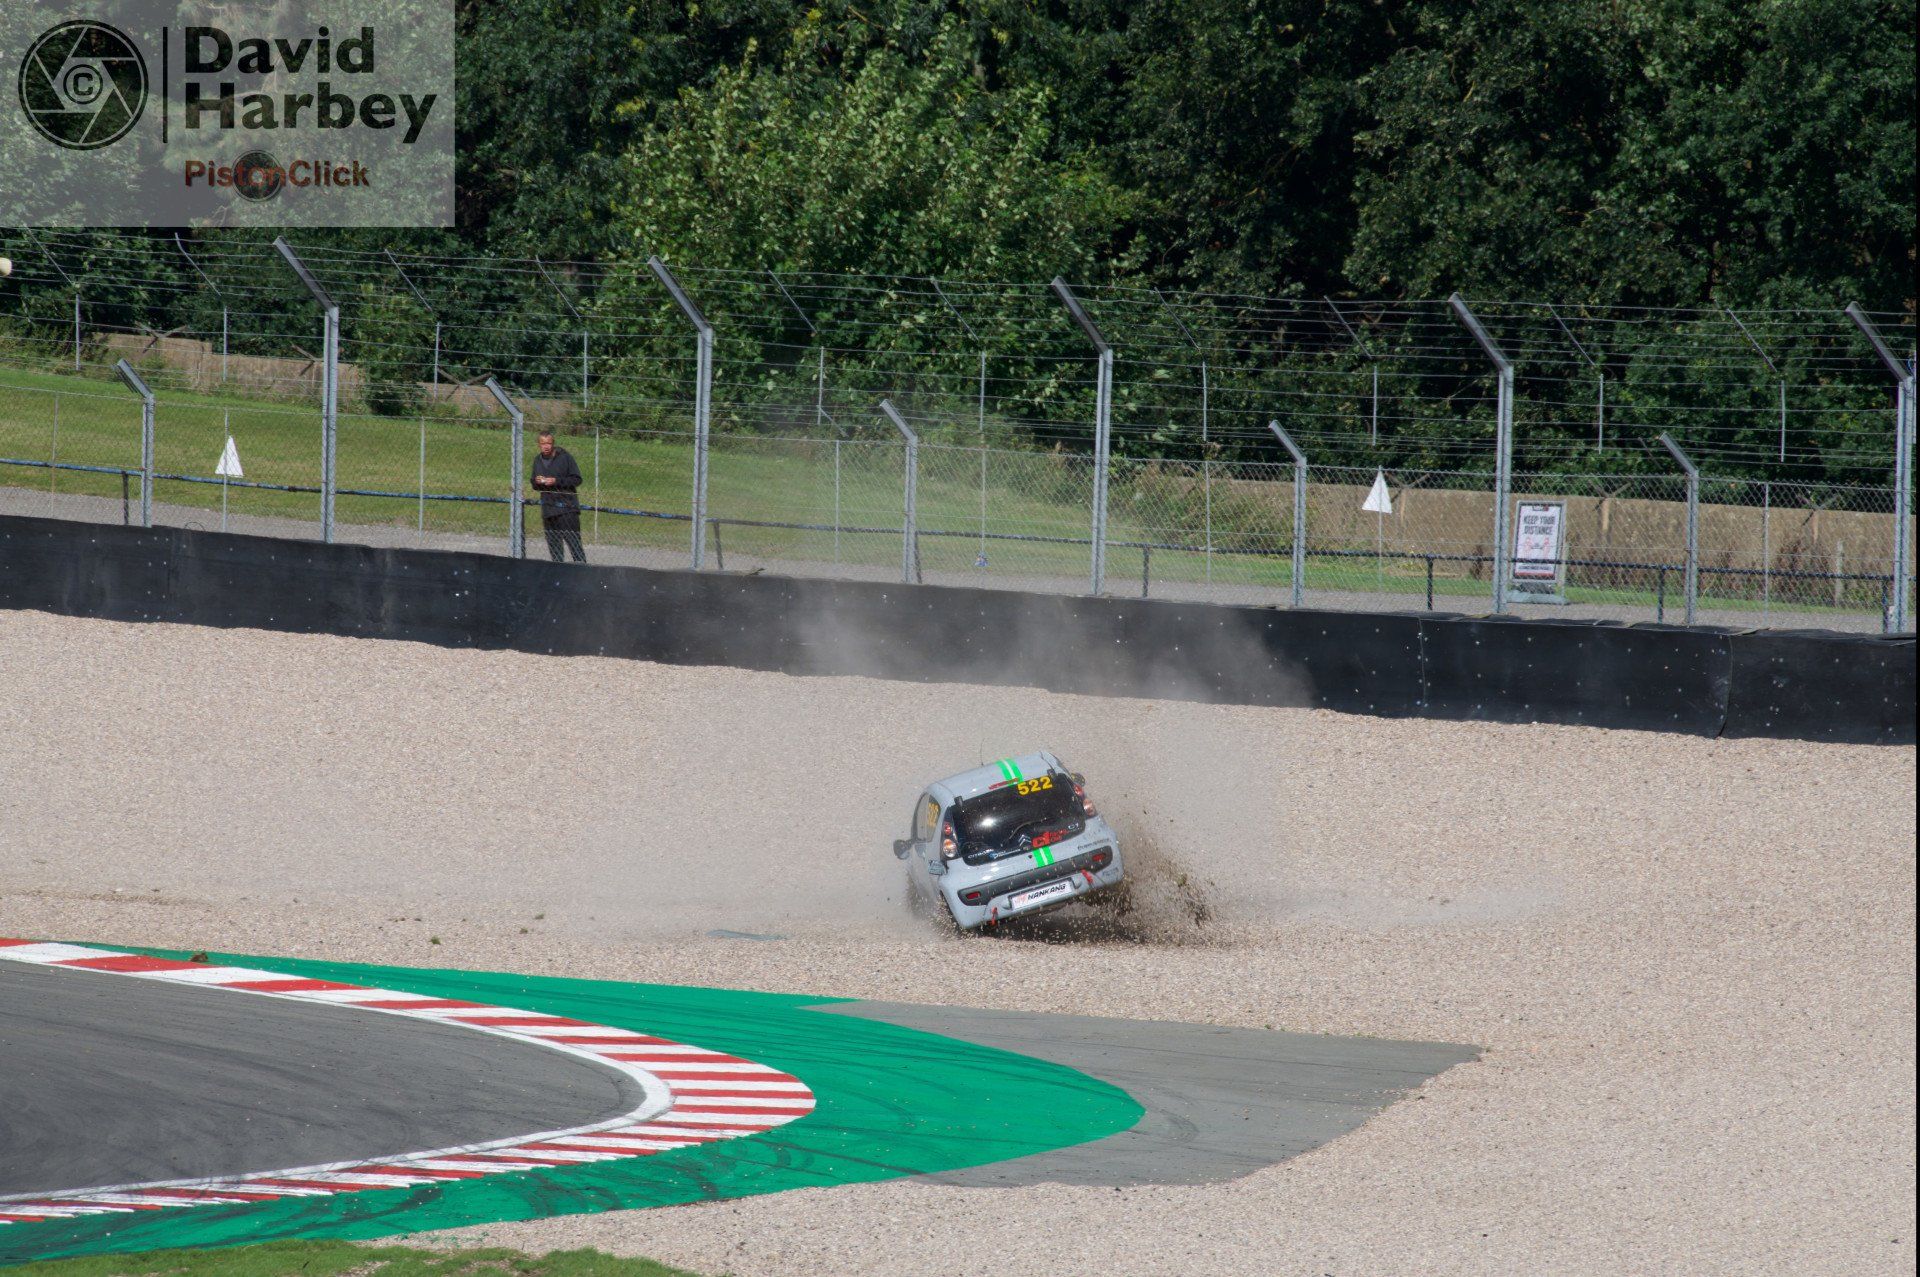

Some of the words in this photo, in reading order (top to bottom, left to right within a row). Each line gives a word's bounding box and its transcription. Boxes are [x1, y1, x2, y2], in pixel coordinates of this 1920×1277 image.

[1524, 515, 1539, 524] KEEP
[1540, 516, 1555, 524] YOUR
[1524, 525, 1553, 535] DISTANCE
[1017, 776, 1053, 796] 522
[1028, 884, 1066, 900] NANKANG
